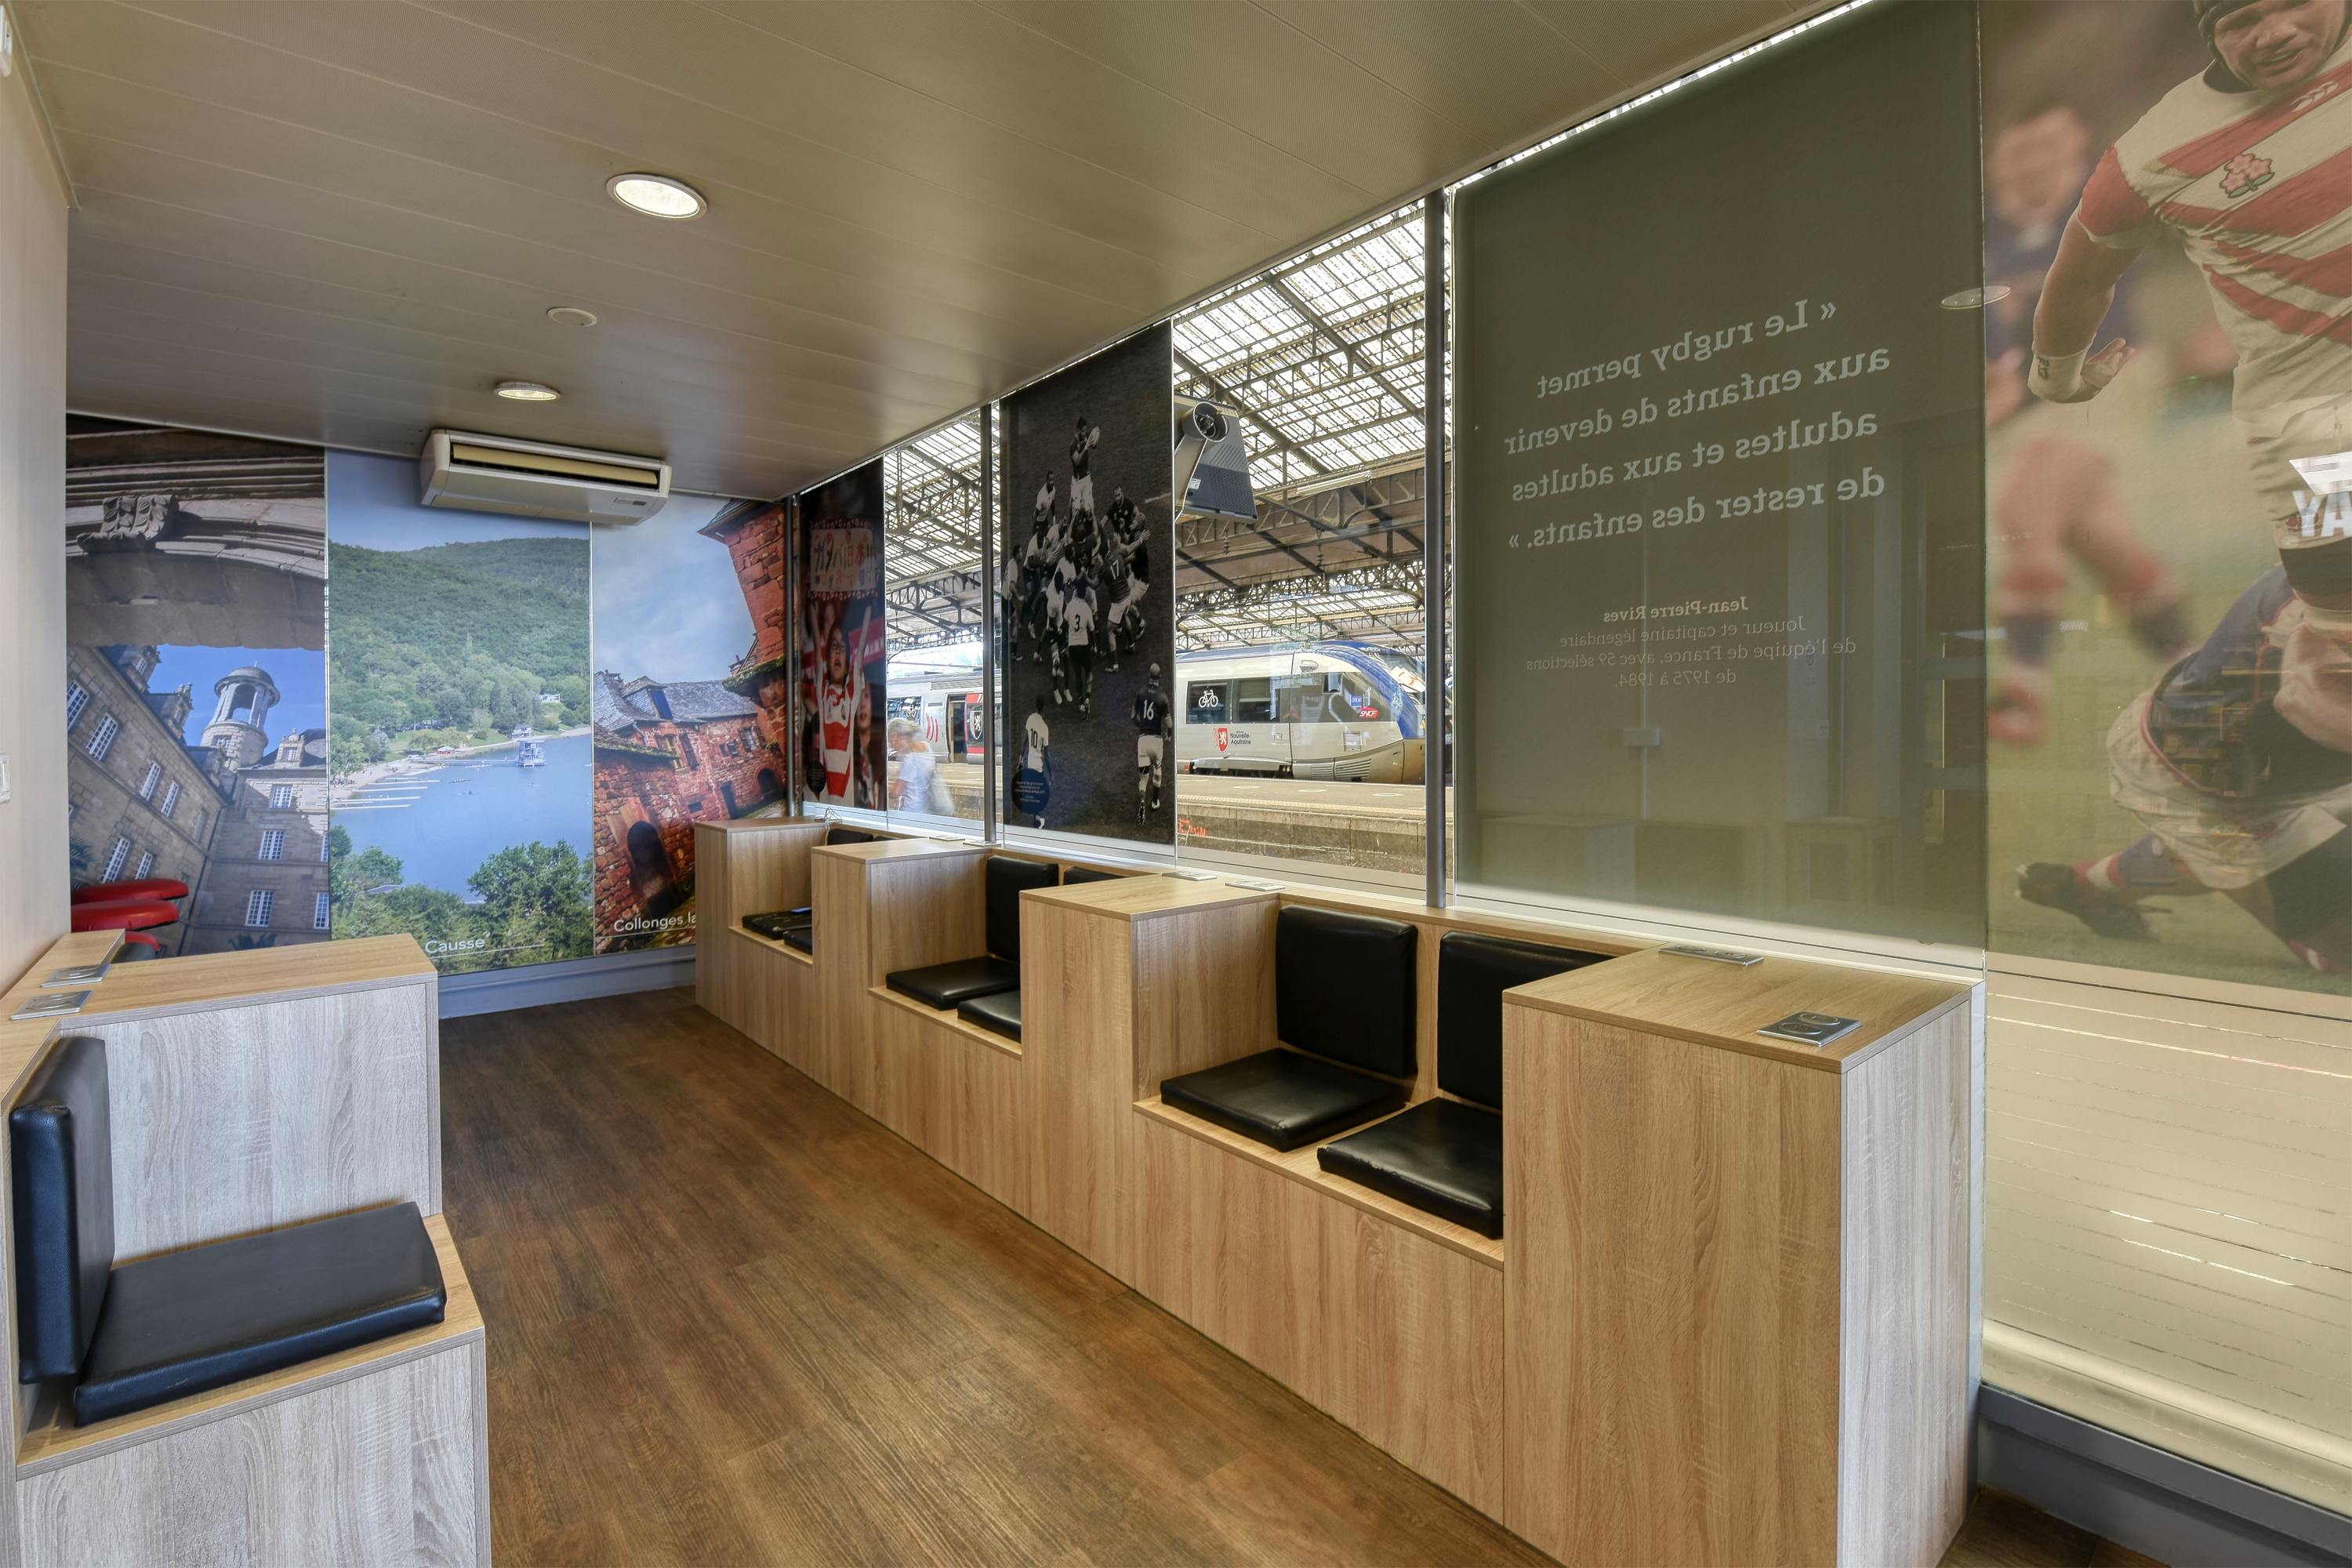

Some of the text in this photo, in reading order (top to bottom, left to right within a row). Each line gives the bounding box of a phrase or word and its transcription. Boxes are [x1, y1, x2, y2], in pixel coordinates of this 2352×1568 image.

[1110, 559, 1119, 580] 17
[1074, 614, 1080, 632] 3
[1143, 699, 1154, 720] 16
[1031, 728, 1038, 749] 10
[613, 915, 684, 933] Collonges
[424, 938, 485, 953] Causse
